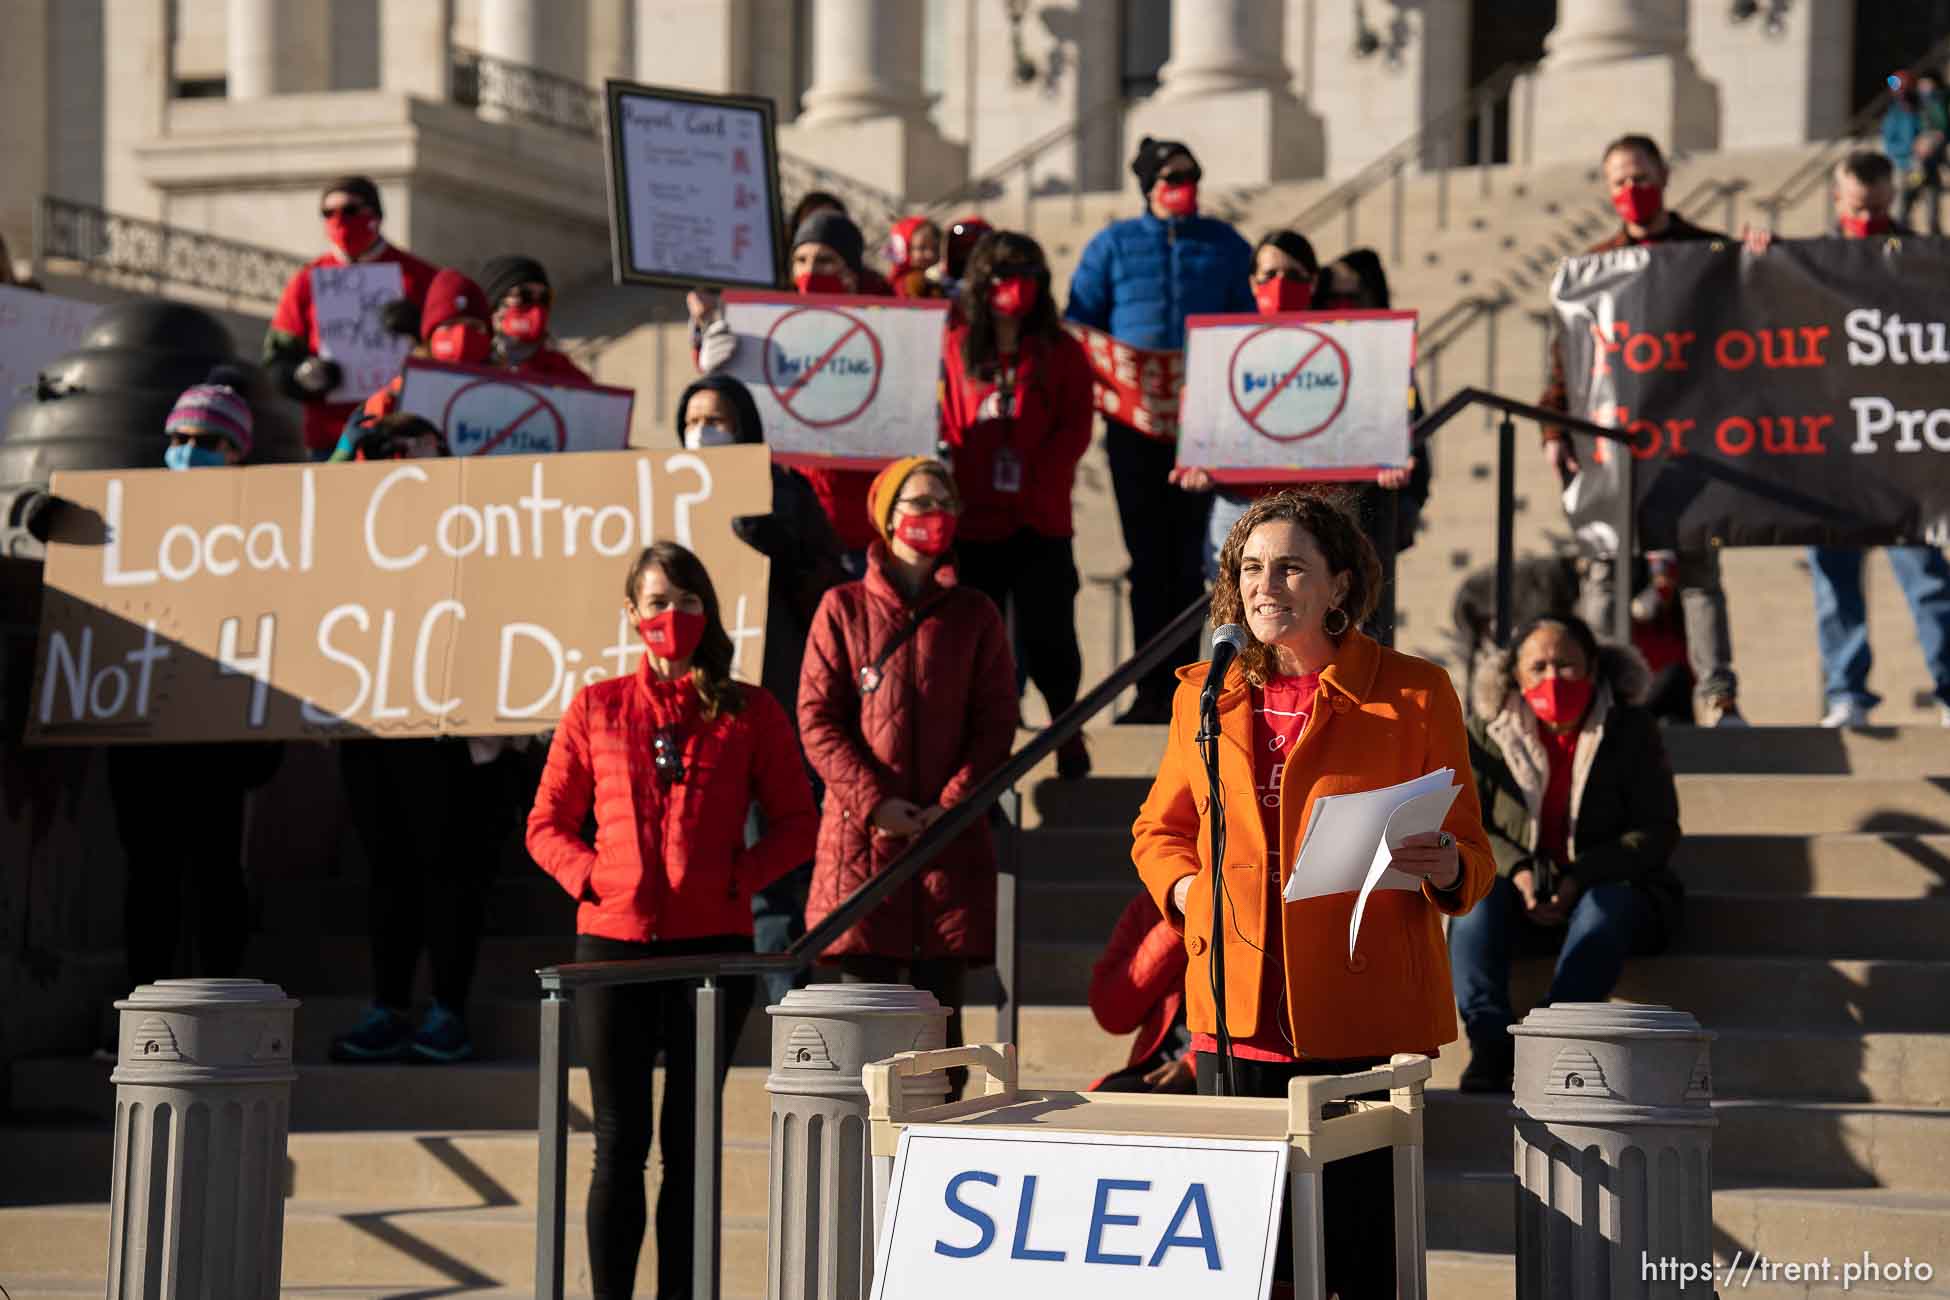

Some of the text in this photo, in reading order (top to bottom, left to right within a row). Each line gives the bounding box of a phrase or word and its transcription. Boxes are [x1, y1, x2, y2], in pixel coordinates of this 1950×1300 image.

[1715, 325, 1830, 370] our
[1715, 413, 1834, 456] our
[103, 468, 317, 587] Local
[40, 620, 172, 724] Not
[218, 613, 275, 727] 4
[301, 602, 466, 722] SLC
[934, 1170, 1222, 1271] SLEA
